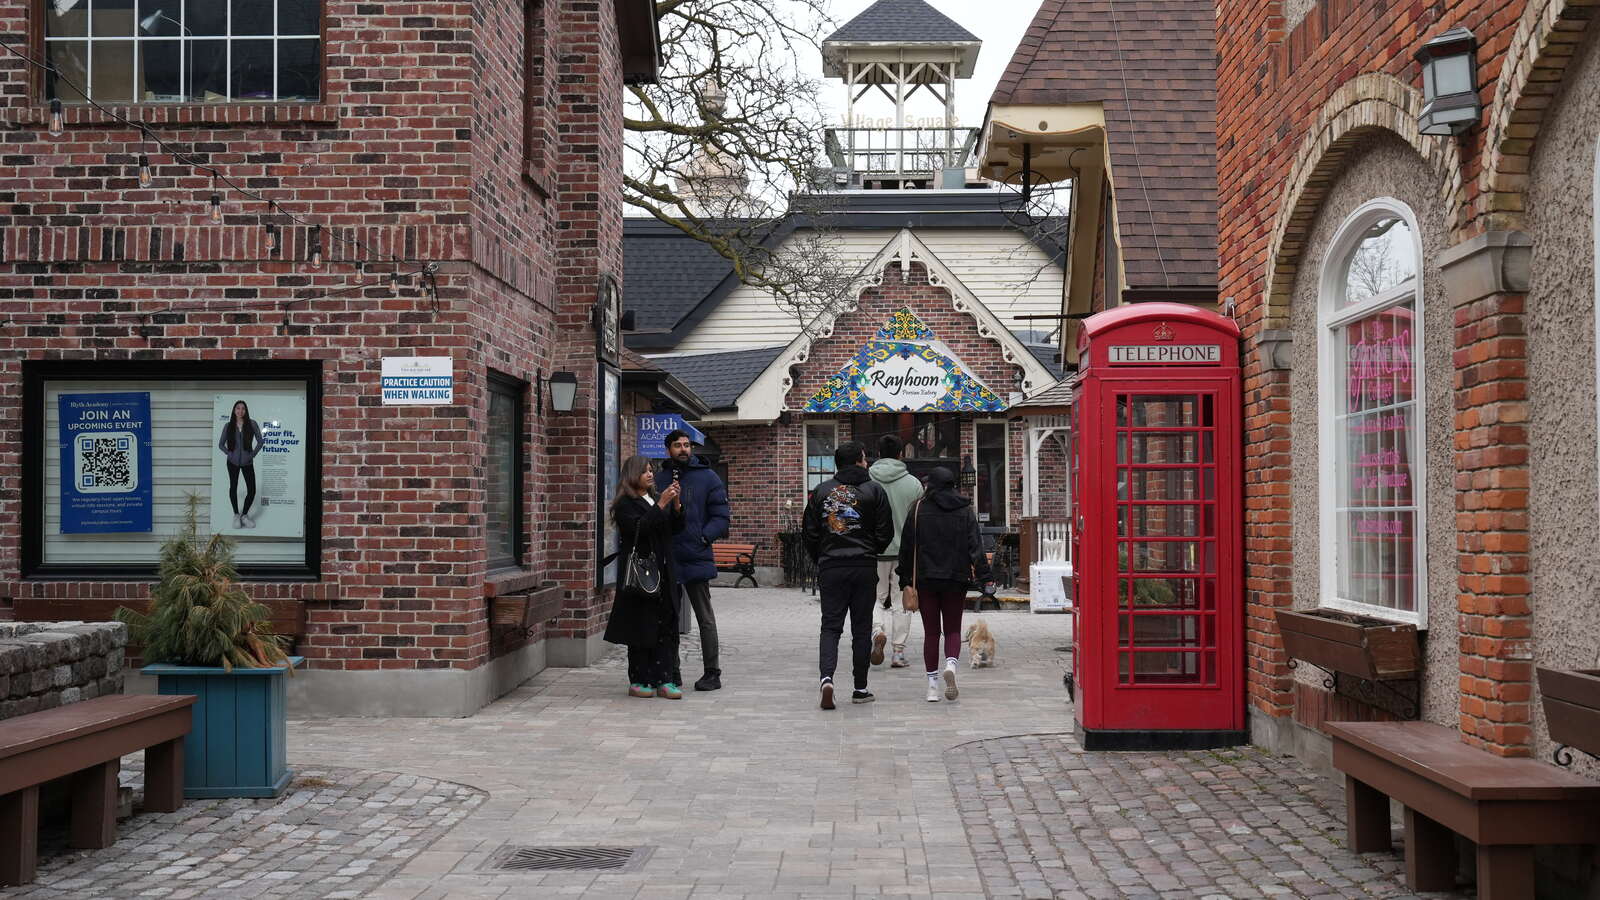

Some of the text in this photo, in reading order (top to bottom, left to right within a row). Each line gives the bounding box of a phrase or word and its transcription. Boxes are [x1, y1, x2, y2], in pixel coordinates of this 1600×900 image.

[1112, 346, 1217, 361] TELEPHONE
[384, 378, 450, 387] PRACTICE CAUTION
[870, 366, 939, 396] Rayhoon
[383, 390, 450, 399] WHEN WALKING
[80, 409, 131, 420] JOIN AN
[68, 421, 143, 430] UPCOMING EVENT
[640, 417, 678, 434] Blyth
[262, 430, 296, 438] your fit,
[262, 437, 279, 445] find
